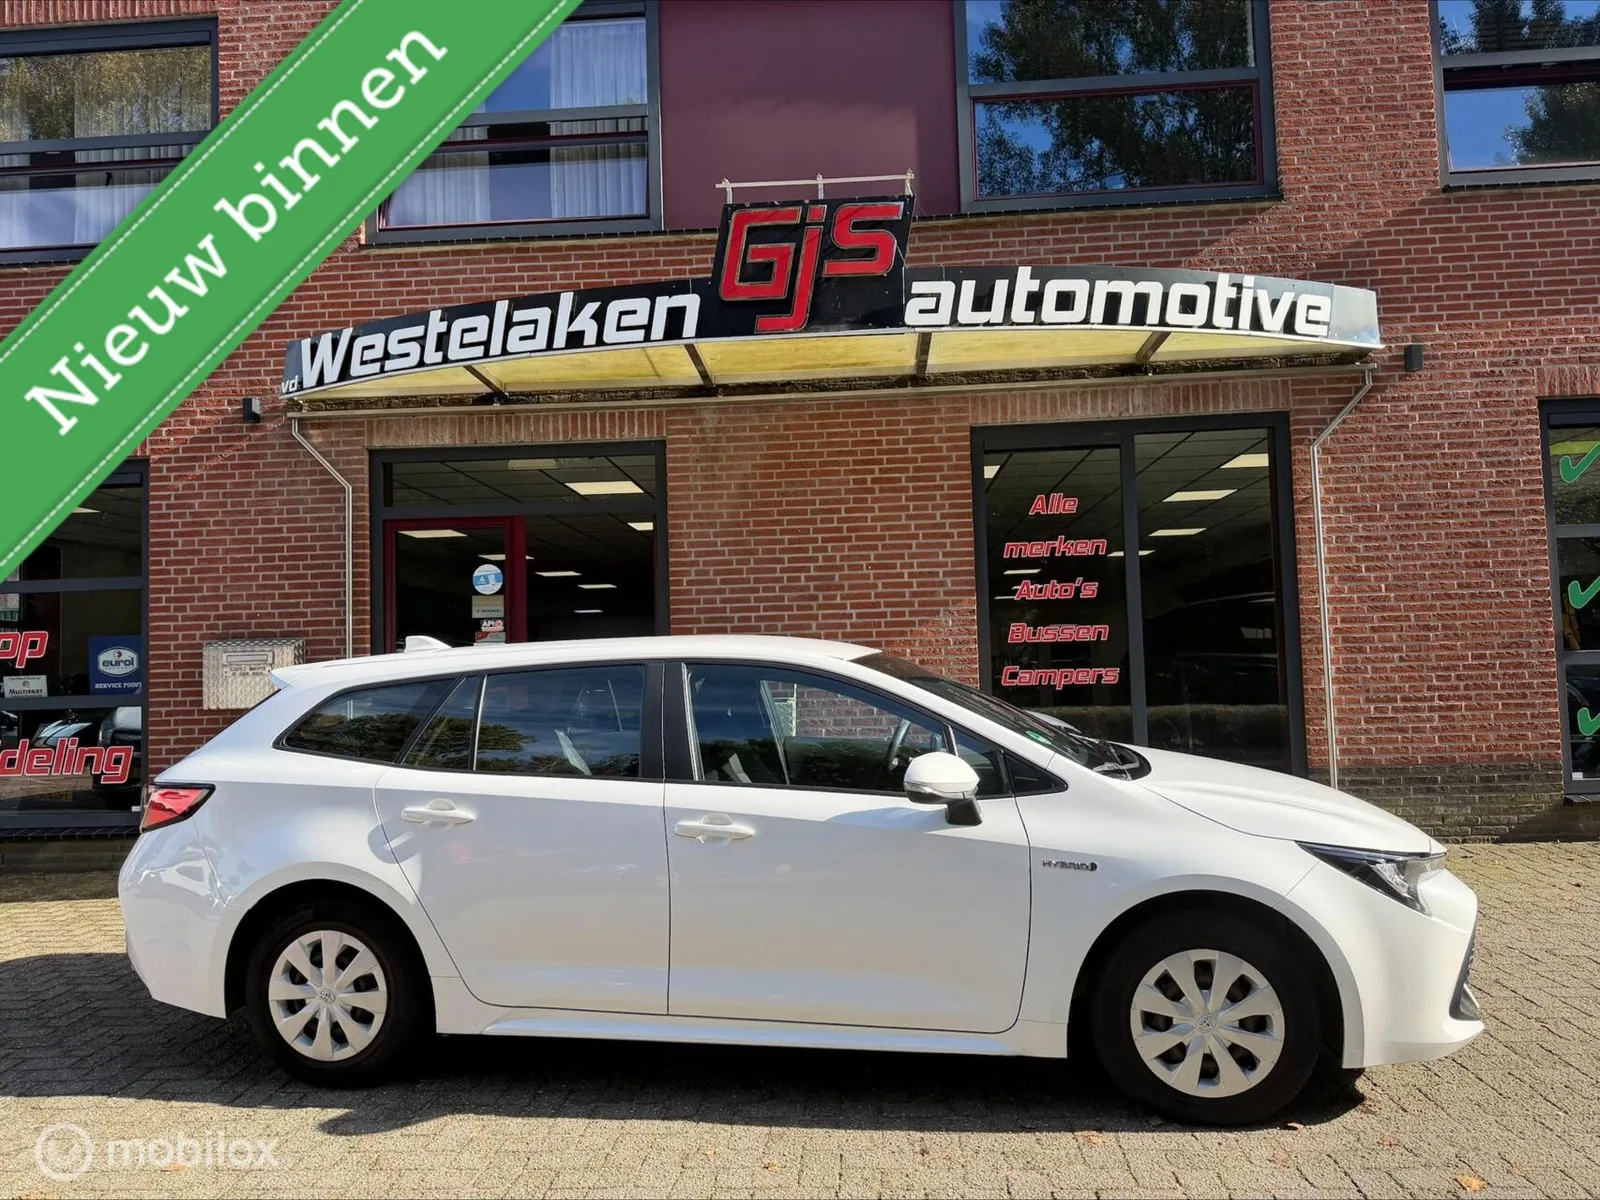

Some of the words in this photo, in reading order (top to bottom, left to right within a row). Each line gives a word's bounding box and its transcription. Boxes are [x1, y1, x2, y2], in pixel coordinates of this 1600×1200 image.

[281, 375, 298, 394] vd
[301, 291, 701, 388] Westelaken
[904, 266, 1332, 335] automotive
[1028, 493, 1079, 516] Alle
[1003, 535, 1107, 558] merken
[1014, 577, 1098, 600] Auto's
[1008, 622, 1109, 643] Bussen
[102, 656, 134, 667] eurol
[1001, 665, 1120, 690] Campers
[0, 737, 134, 784] deling
[1042, 859, 1089, 870] HYBRID
